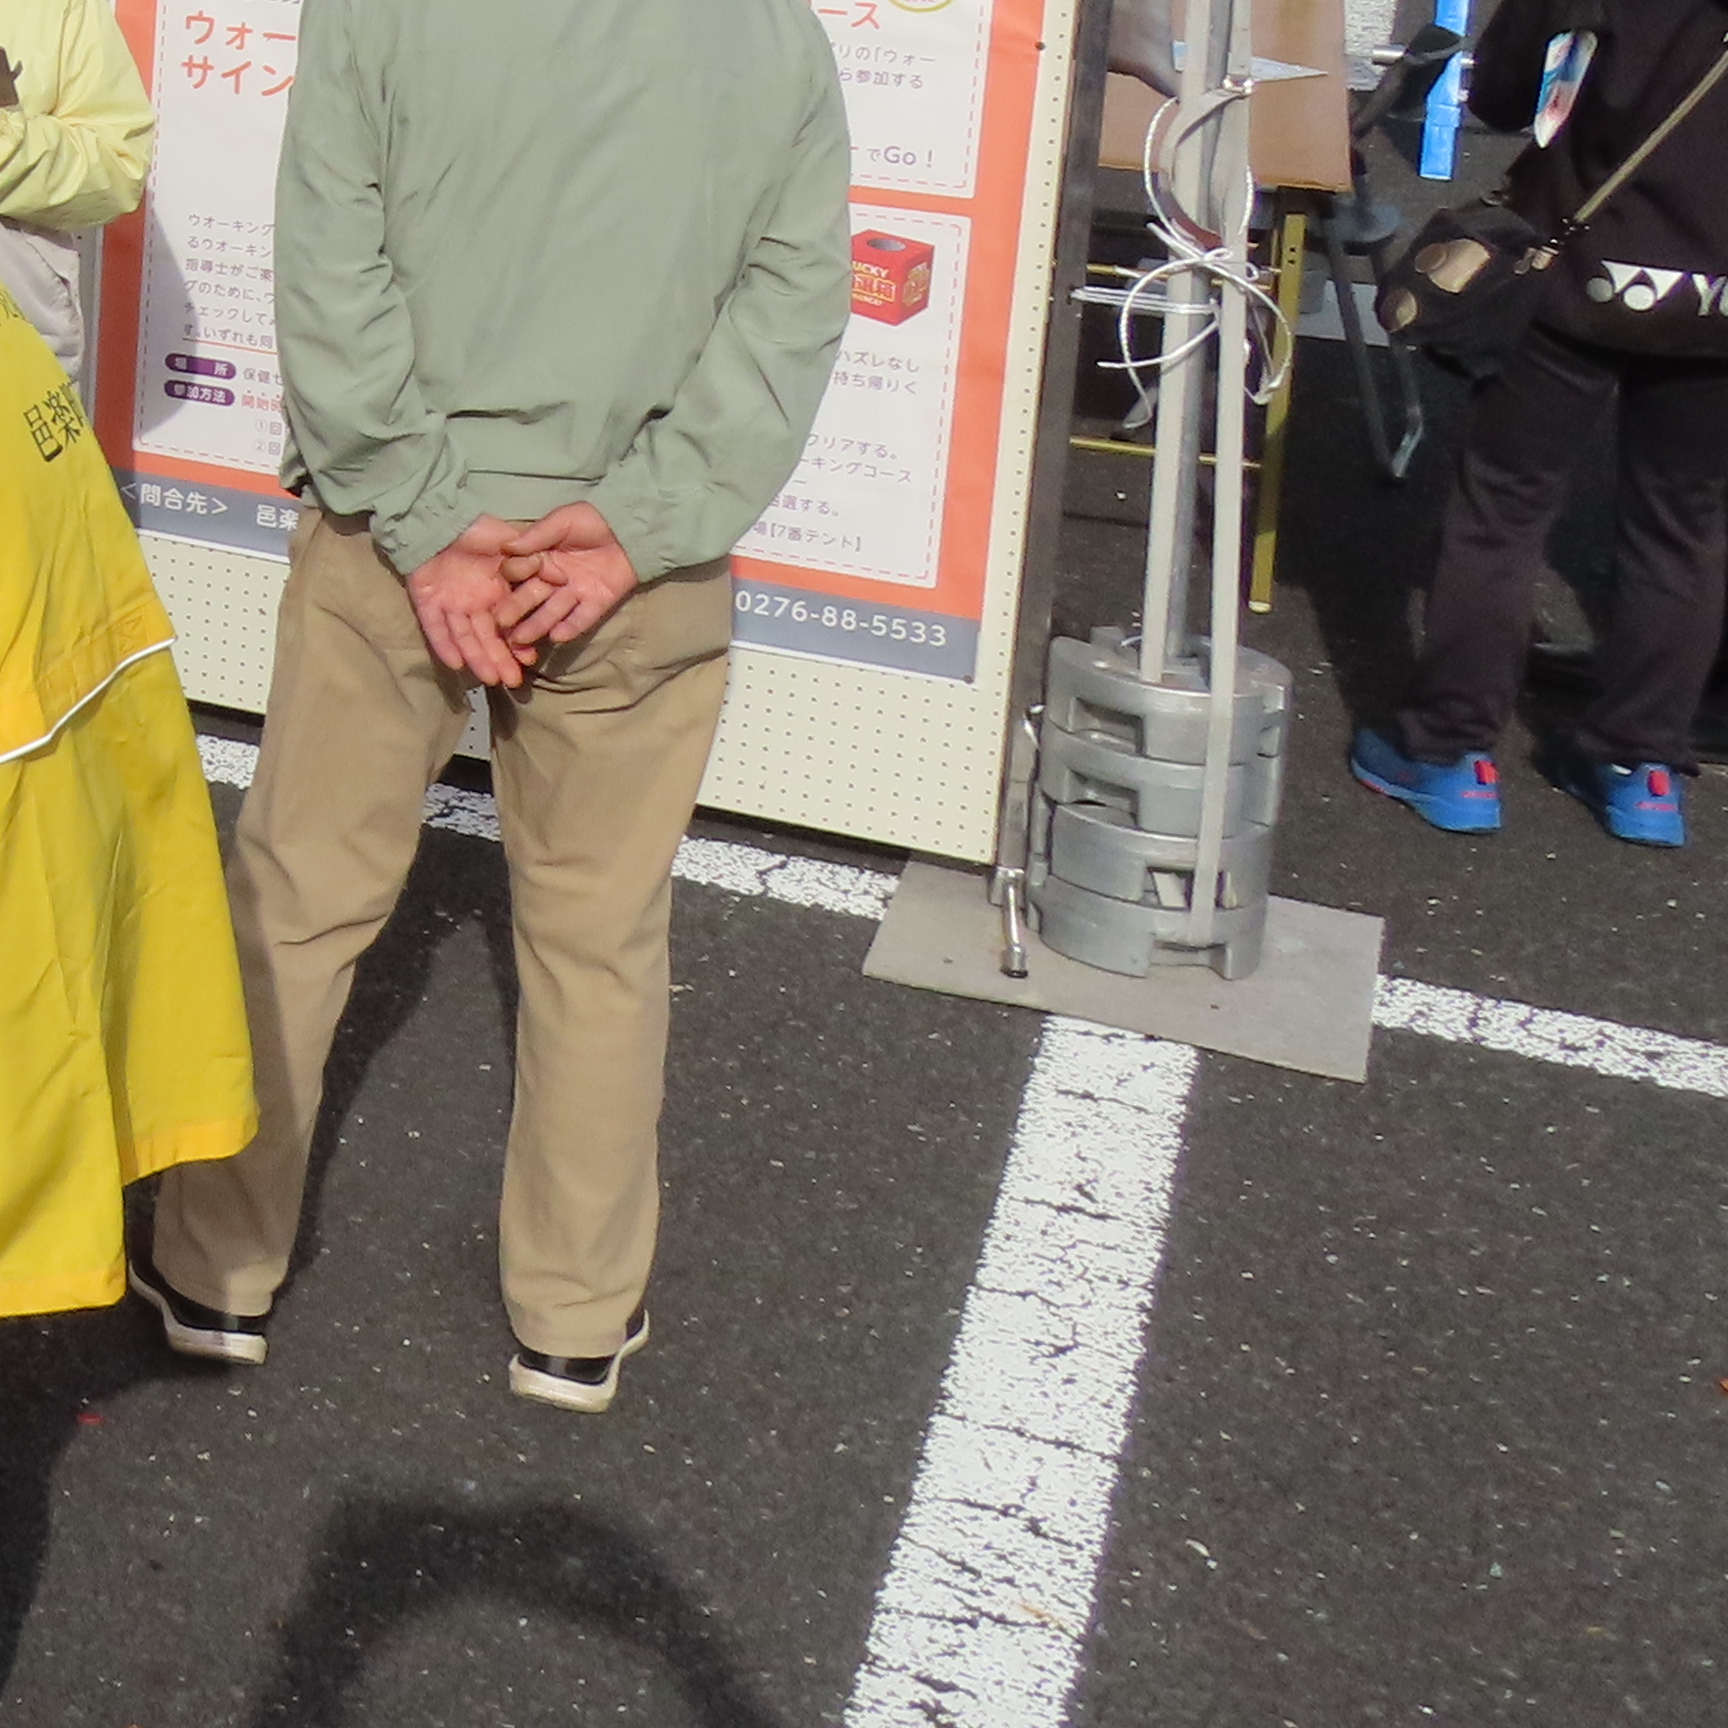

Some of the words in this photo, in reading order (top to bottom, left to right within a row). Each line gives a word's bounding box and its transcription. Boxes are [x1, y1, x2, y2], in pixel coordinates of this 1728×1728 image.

[808, 0, 881, 30] ース
[180, 54, 297, 97] サイン
[735, 589, 947, 648] 0276-88-5533
